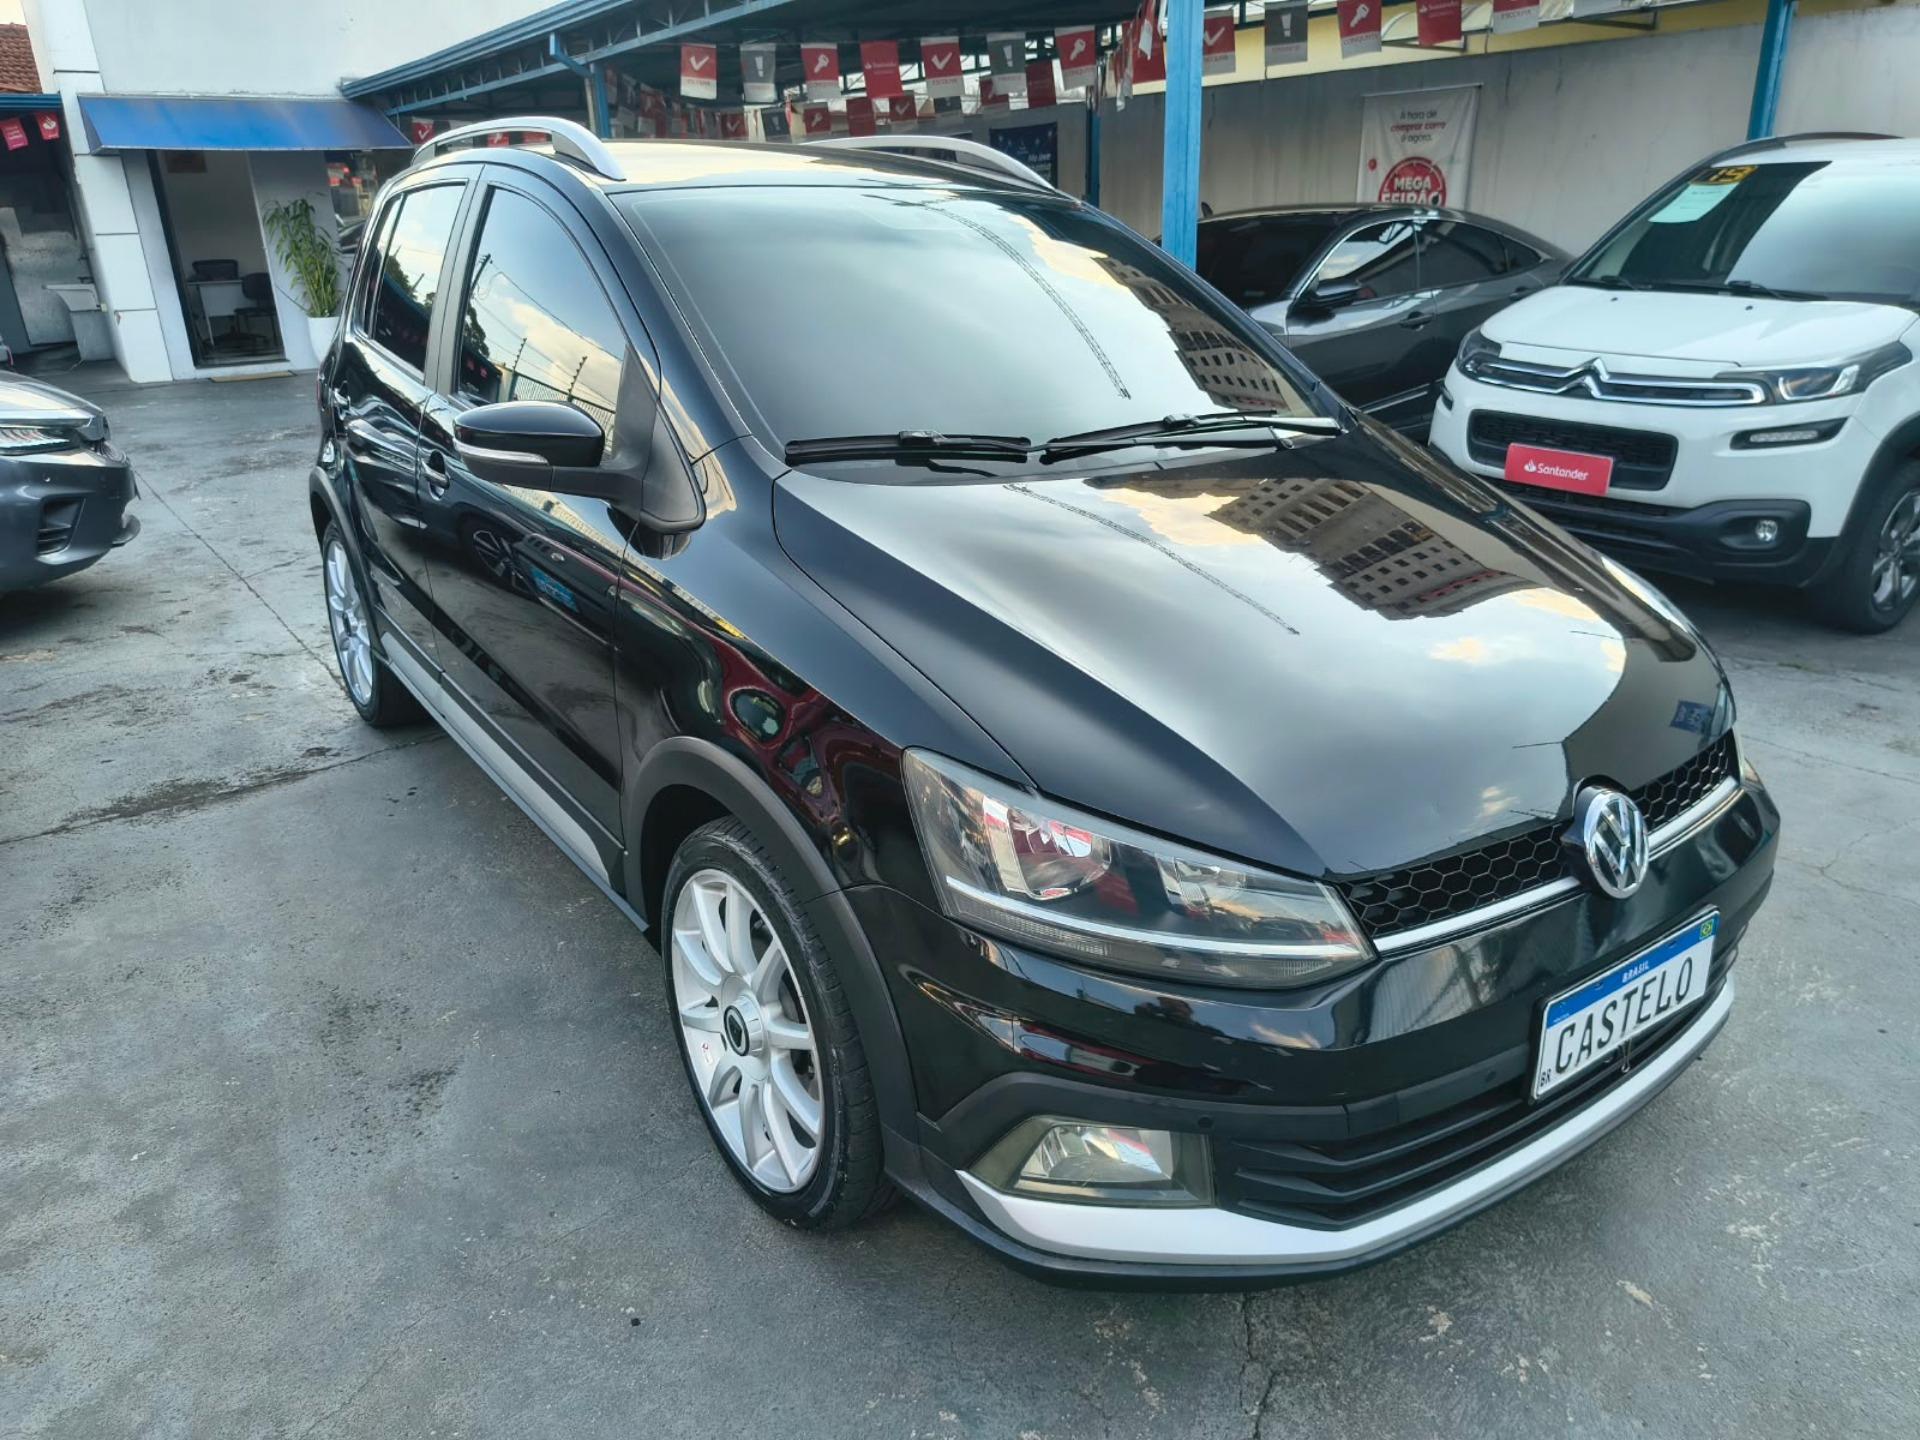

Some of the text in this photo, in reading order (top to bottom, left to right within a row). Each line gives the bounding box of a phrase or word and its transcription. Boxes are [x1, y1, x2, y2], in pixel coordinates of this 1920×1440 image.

[1407, 111, 1425, 119] hora
[1391, 123, 1422, 133] comprar
[1395, 176, 1432, 191] MEGA
[1537, 462, 1589, 481] Santander
[1622, 960, 1650, 983] BRASIL
[1555, 957, 1693, 1075] CASTELO
